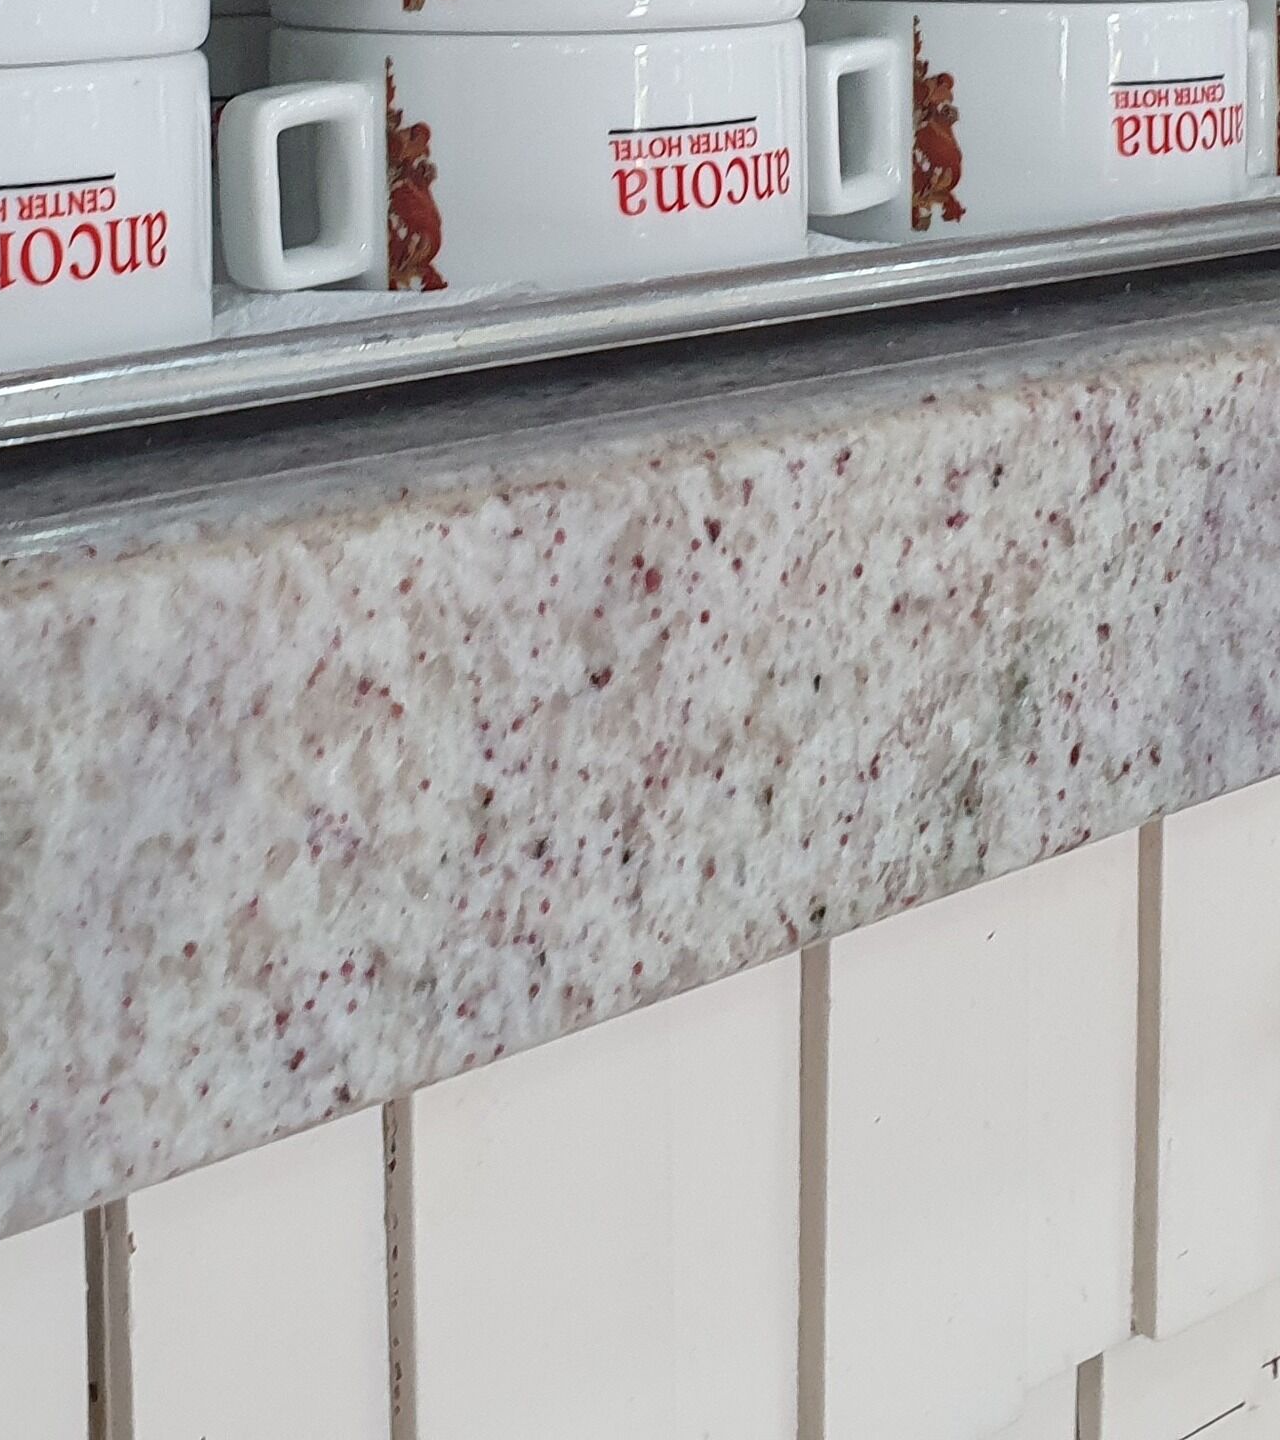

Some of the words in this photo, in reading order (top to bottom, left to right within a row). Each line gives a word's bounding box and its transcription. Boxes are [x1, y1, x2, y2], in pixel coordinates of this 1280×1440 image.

[1111, 89, 1170, 110] HOTEL
[1174, 83, 1225, 103] CENTER
[688, 126, 758, 156] CENTER
[1111, 103, 1244, 158] ancona
[608, 136, 682, 160] HOTEL
[611, 147, 790, 217] ancona
[16, 185, 116, 221] CENTER
